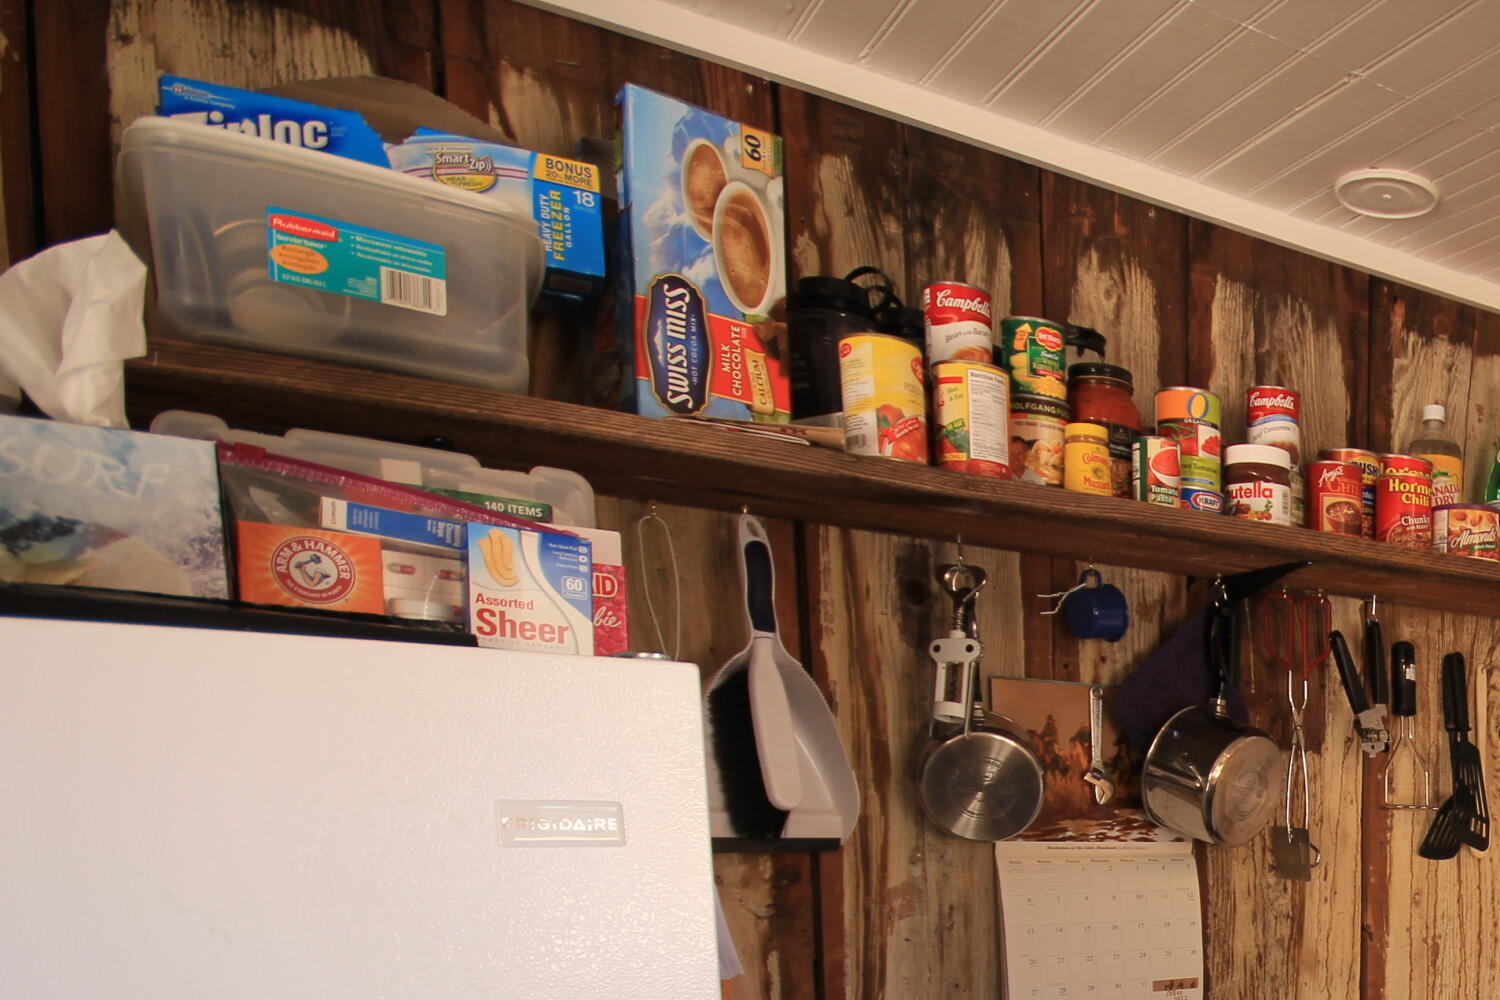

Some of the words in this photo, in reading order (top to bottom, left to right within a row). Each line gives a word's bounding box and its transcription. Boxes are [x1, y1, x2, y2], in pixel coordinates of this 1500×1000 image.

[744, 134, 762, 162] 60
[435, 151, 469, 165] Smart
[469, 157, 487, 173] Zip
[545, 158, 592, 178] BONUS
[564, 173, 592, 187] MORE
[539, 193, 550, 219] DUTY
[572, 190, 595, 207] 18
[273, 217, 336, 240] Rubbermaid
[550, 190, 566, 261] FREEZER
[562, 205, 573, 249] GALLON
[720, 343, 732, 373] MILK
[731, 325, 743, 397] CHOCOLATE
[667, 341, 693, 409] SWISS
[751, 359, 768, 406] CALCIUM
[1011, 400, 1056, 414] OLFGANG
[1318, 466, 1345, 488] Amy's
[1388, 479, 1431, 495] Horme
[1151, 494, 1174, 504] Paste
[1231, 481, 1273, 499] utella
[1401, 492, 1430, 507] Chili
[1434, 495, 1456, 506] DRY
[484, 501, 504, 513] 140
[508, 504, 543, 518] ITEMS
[1198, 496, 1220, 508] KRAFT
[1450, 525, 1496, 549] Almonds
[276, 544, 294, 573] ARM
[292, 541, 302, 551] &
[304, 540, 350, 580] HAMMER
[565, 578, 583, 592] 60
[475, 592, 534, 611] Assorted
[476, 608, 570, 645] Sheer
